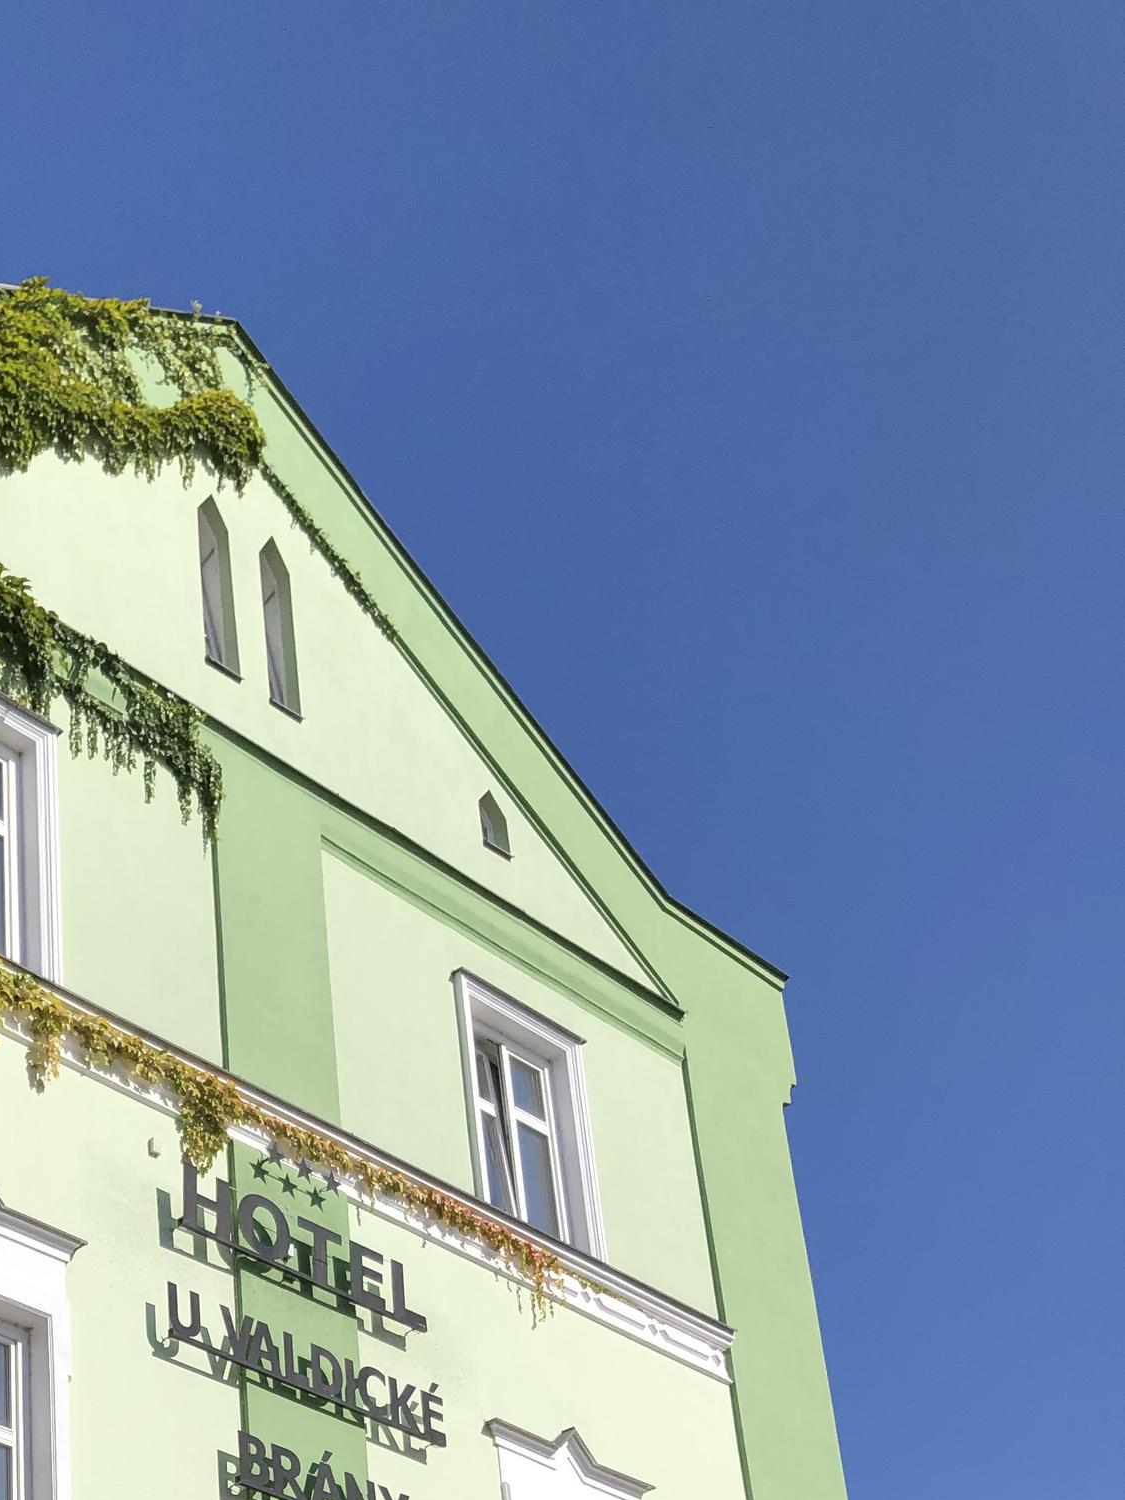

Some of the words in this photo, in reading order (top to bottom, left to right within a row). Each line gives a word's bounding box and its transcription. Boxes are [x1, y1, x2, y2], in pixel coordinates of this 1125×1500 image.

[179, 1162, 427, 1332] HOTEL
[166, 1281, 201, 1339] U
[220, 1303, 446, 1447] VALDICKÉ
